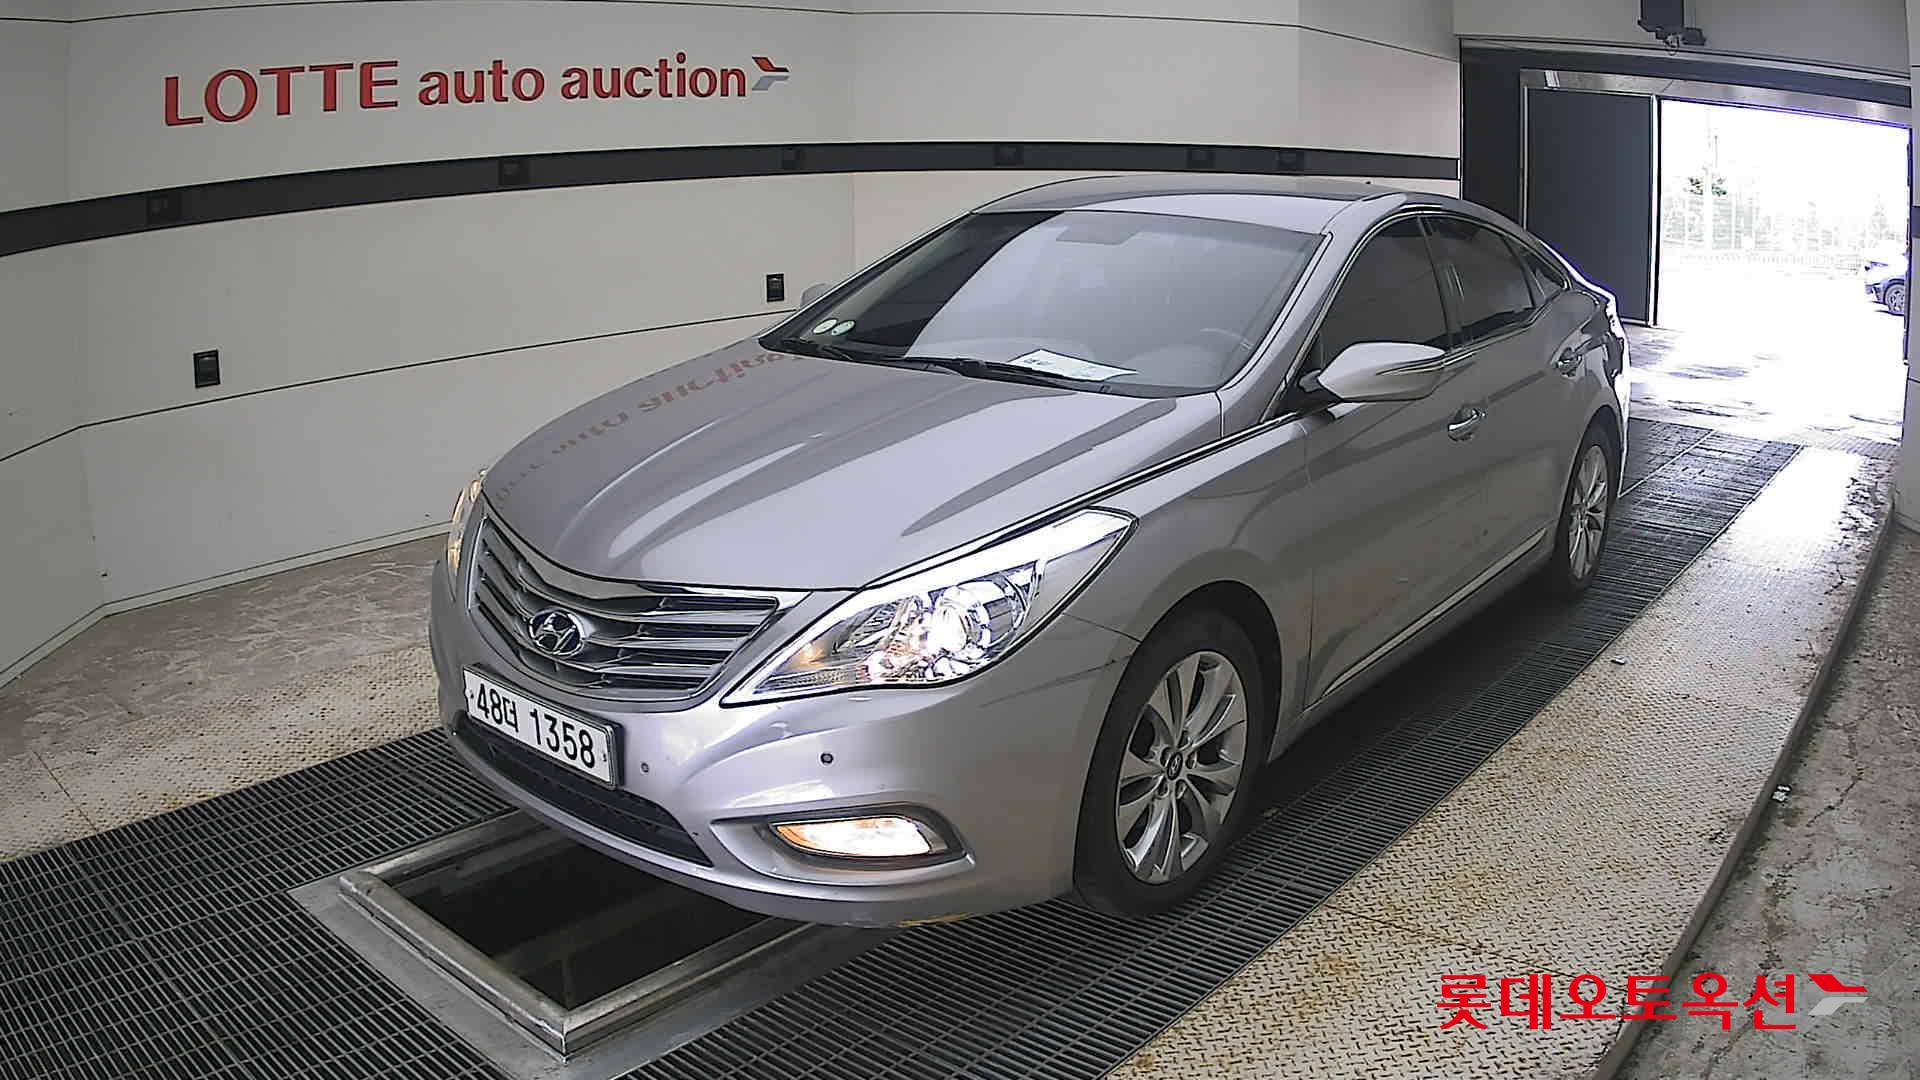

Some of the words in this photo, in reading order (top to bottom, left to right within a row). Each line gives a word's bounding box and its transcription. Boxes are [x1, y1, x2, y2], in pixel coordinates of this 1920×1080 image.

[164, 60, 399, 126] LOTTE
[417, 59, 546, 106] auto
[560, 52, 747, 98] auction
[477, 684, 519, 733] 48더
[530, 708, 595, 769] 1358
